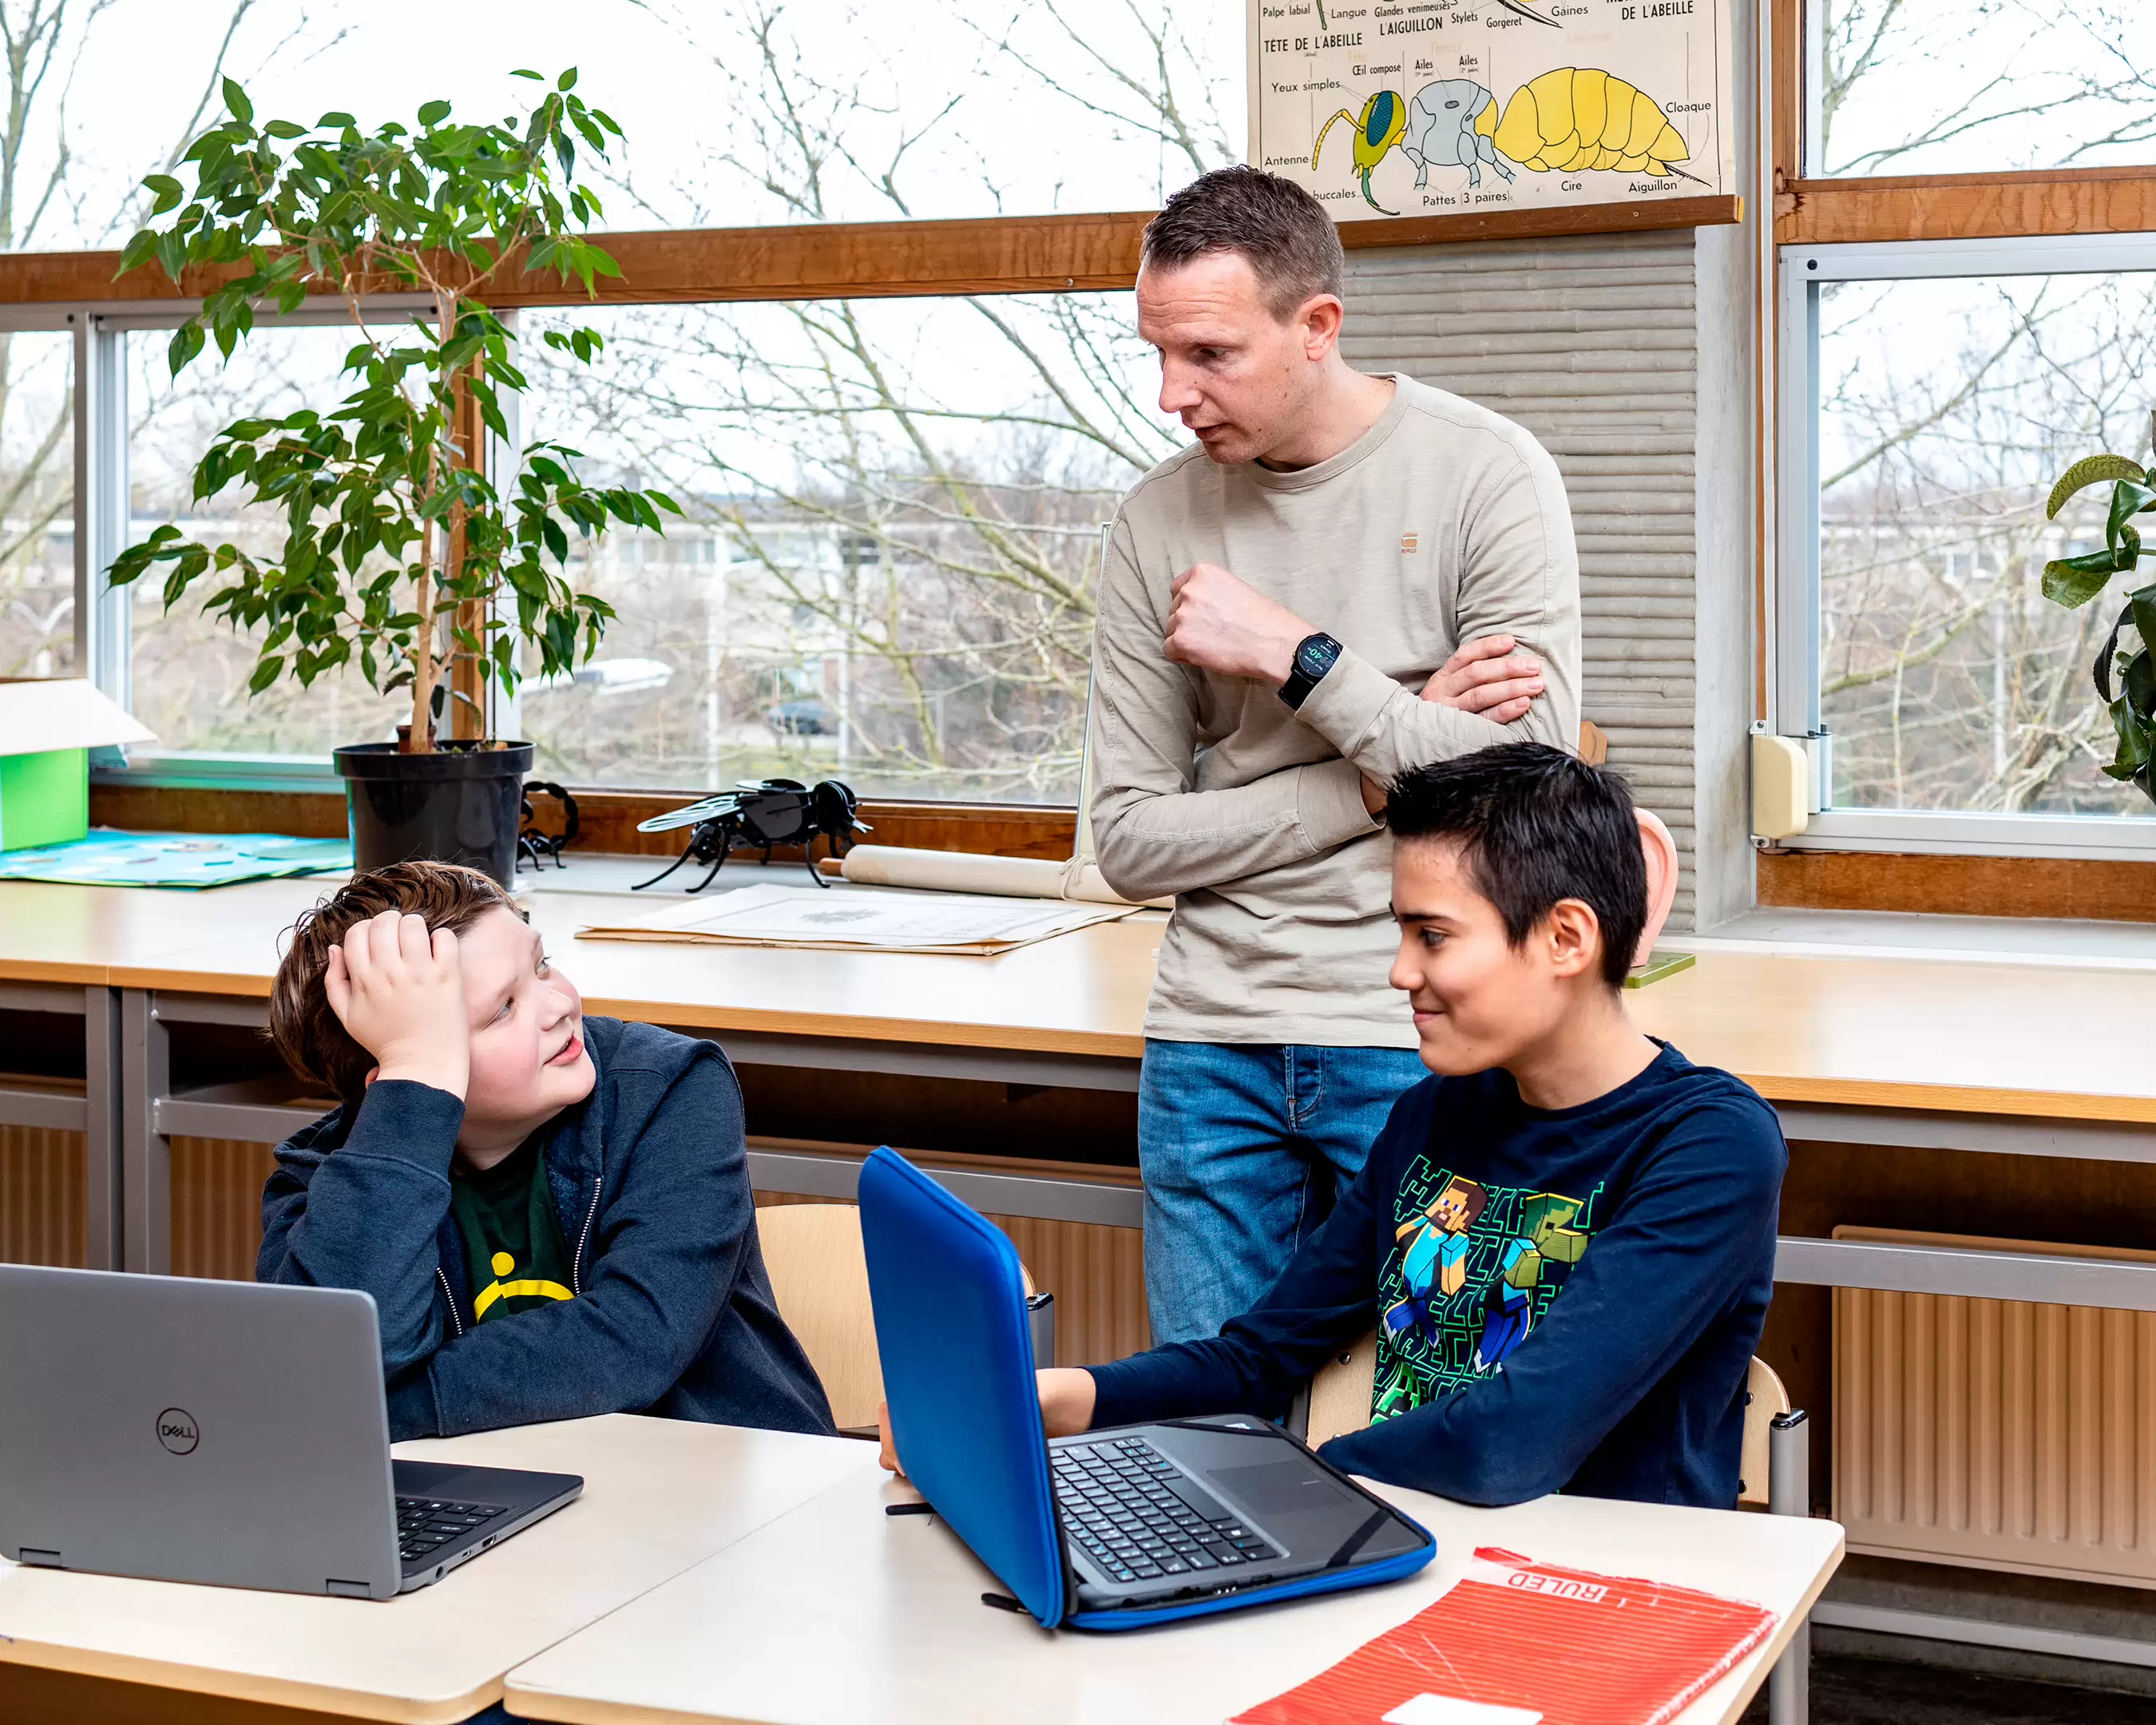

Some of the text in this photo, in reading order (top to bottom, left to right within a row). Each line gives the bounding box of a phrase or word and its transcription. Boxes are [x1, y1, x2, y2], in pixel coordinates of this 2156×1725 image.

[1262, 3, 1310, 18] Palpe labial
[1331, 9, 1367, 19] Langue
[1374, 2, 1451, 17] Glandes venimeuses
[1622, 0, 1694, 20] DE L'ABEILLE
[1451, 11, 1478, 25] Stylets
[1486, 16, 1522, 29] Gorgeret
[1380, 17, 1443, 36] L'AIGUILLON
[1295, 38, 1308, 50] DE
[1315, 33, 1362, 49] L'ABEILLE
[1415, 58, 1433, 69] Ailes
[1459, 54, 1478, 65] Ailes
[1271, 78, 1341, 93] Yeux simples
[1666, 101, 1711, 113] Cloaque
[1264, 156, 1309, 166] Antenne
[1561, 180, 1582, 191] Cire
[1628, 180, 1678, 194] Aiguillon
[1313, 188, 1356, 200] buccales
[1423, 190, 1510, 206] Pattes (3 paires)
[161, 1425, 196, 1438] DELL
[1508, 1572, 1602, 1600] RULED
